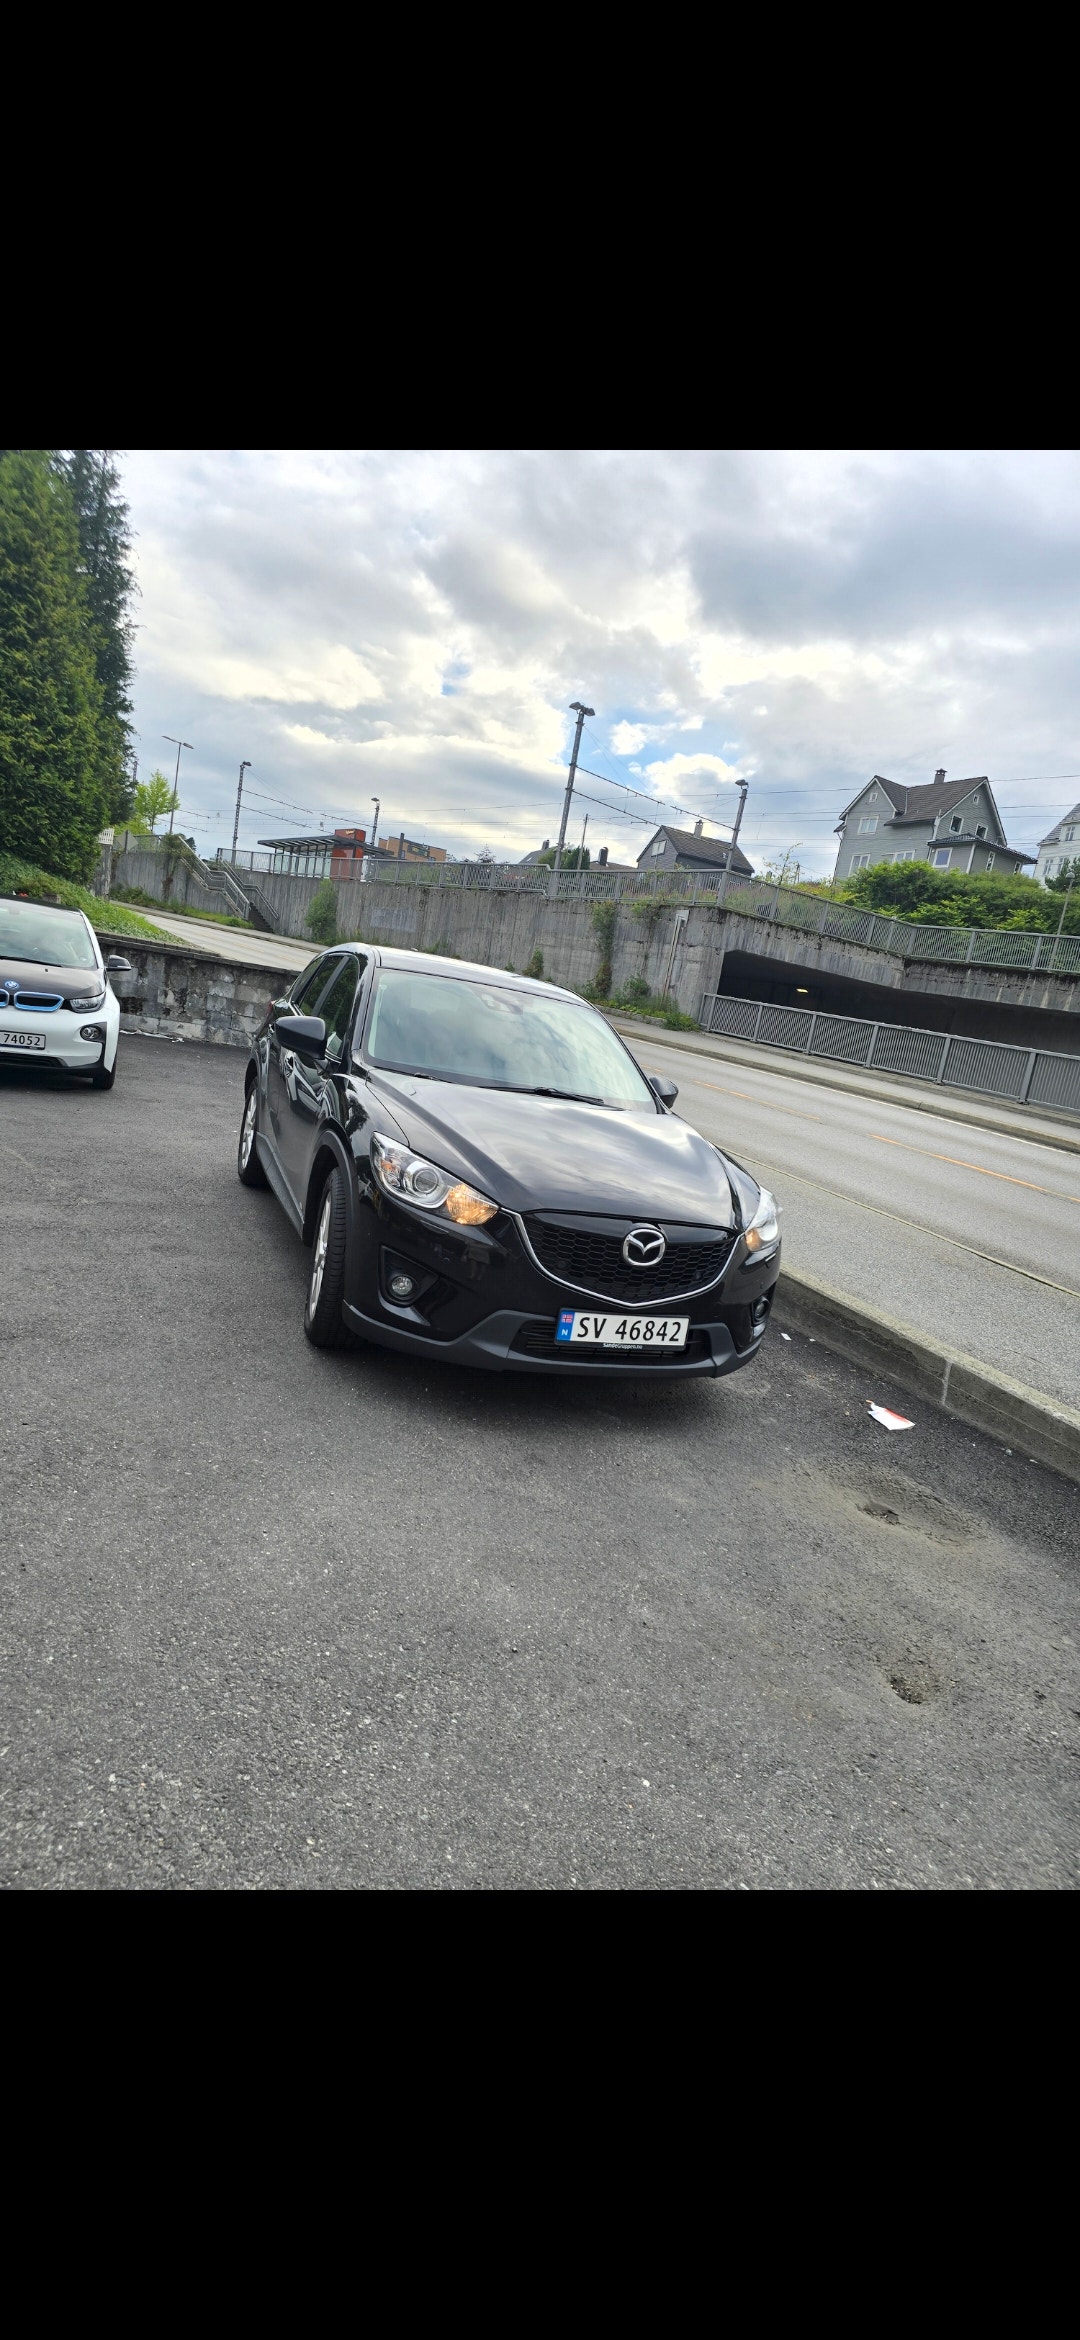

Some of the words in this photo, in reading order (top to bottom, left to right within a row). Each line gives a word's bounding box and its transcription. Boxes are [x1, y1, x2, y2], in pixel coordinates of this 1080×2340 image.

[4, 1033, 40, 1045] 74052
[577, 1317, 607, 1339] SV
[615, 1319, 681, 1342] 46842
